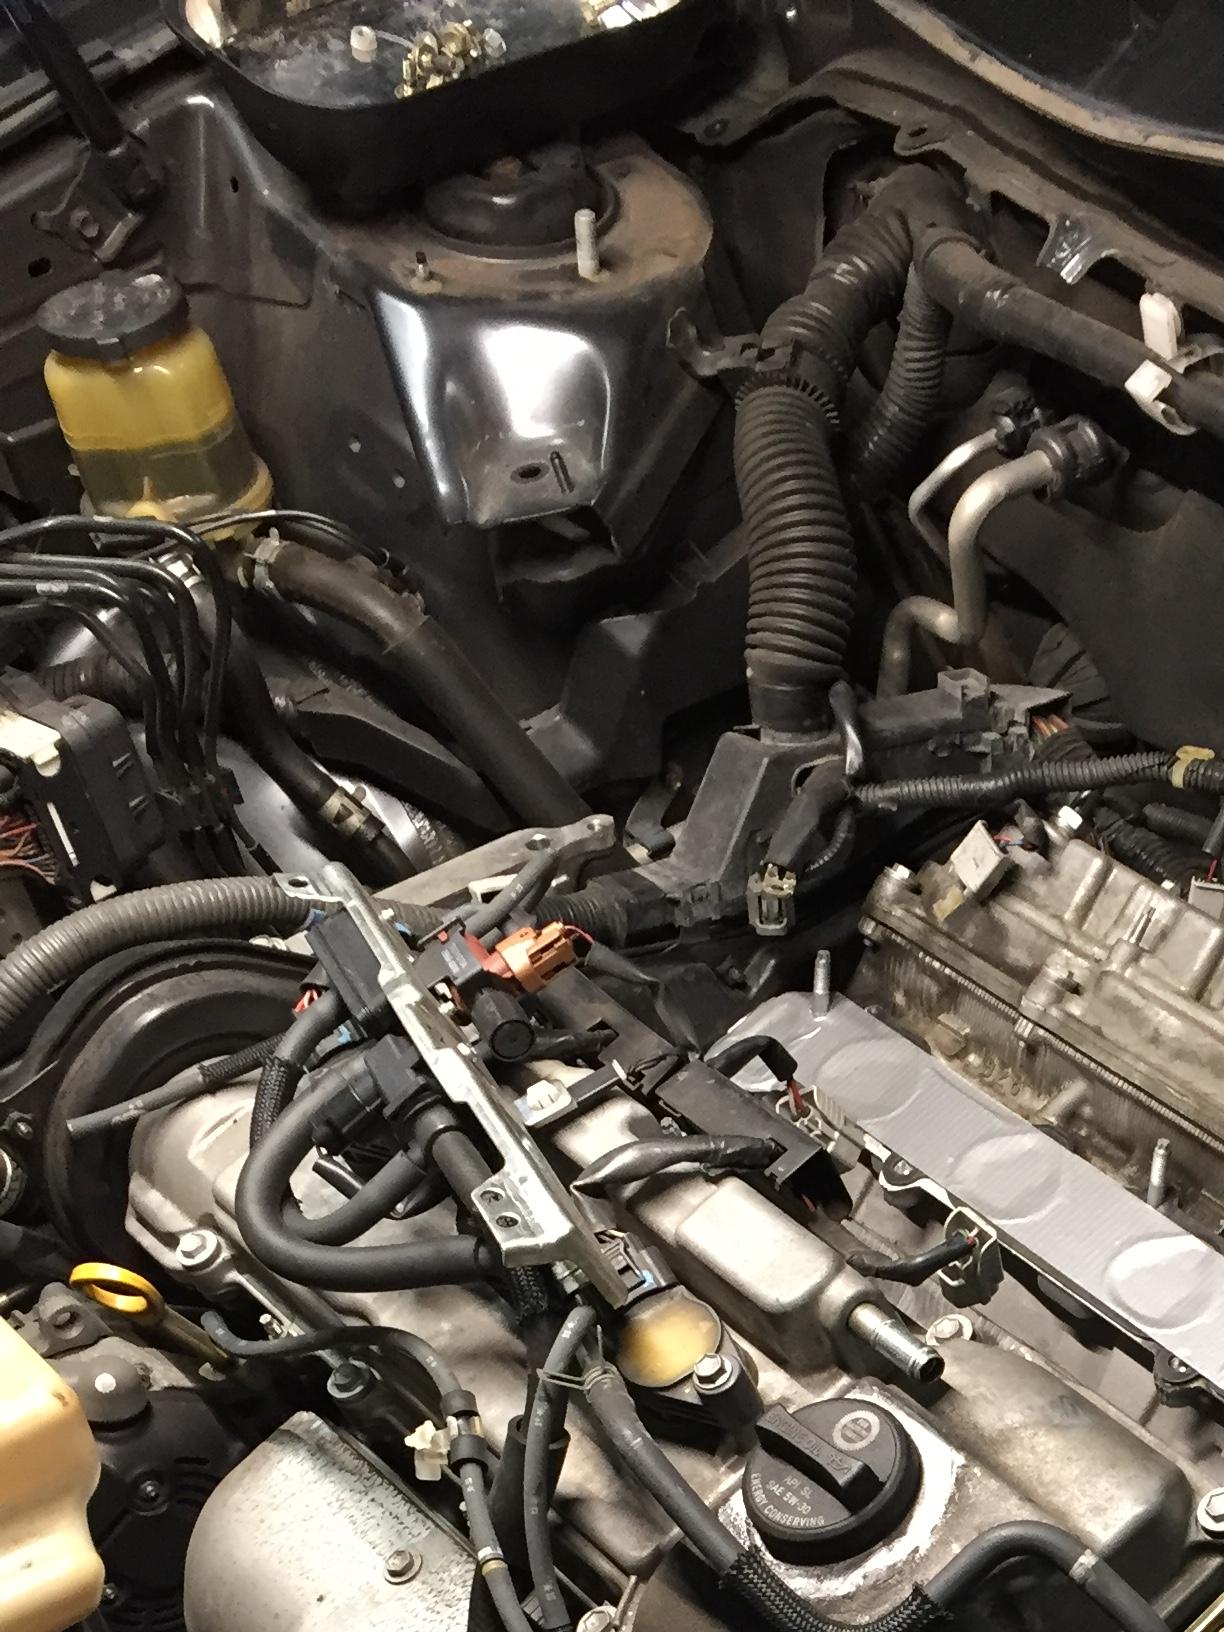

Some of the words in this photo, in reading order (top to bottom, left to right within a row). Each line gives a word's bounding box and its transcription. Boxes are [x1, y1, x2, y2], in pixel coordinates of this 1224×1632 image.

[804, 1438, 822, 1457] OIL
[751, 1472, 769, 1507] ENERGY
[764, 1504, 825, 1526] CONSERVING
[766, 1480, 785, 1496] SAE
[783, 1492, 812, 1515] 5W-30
[783, 1475, 801, 1489] API
[800, 1486, 814, 1500] SL
